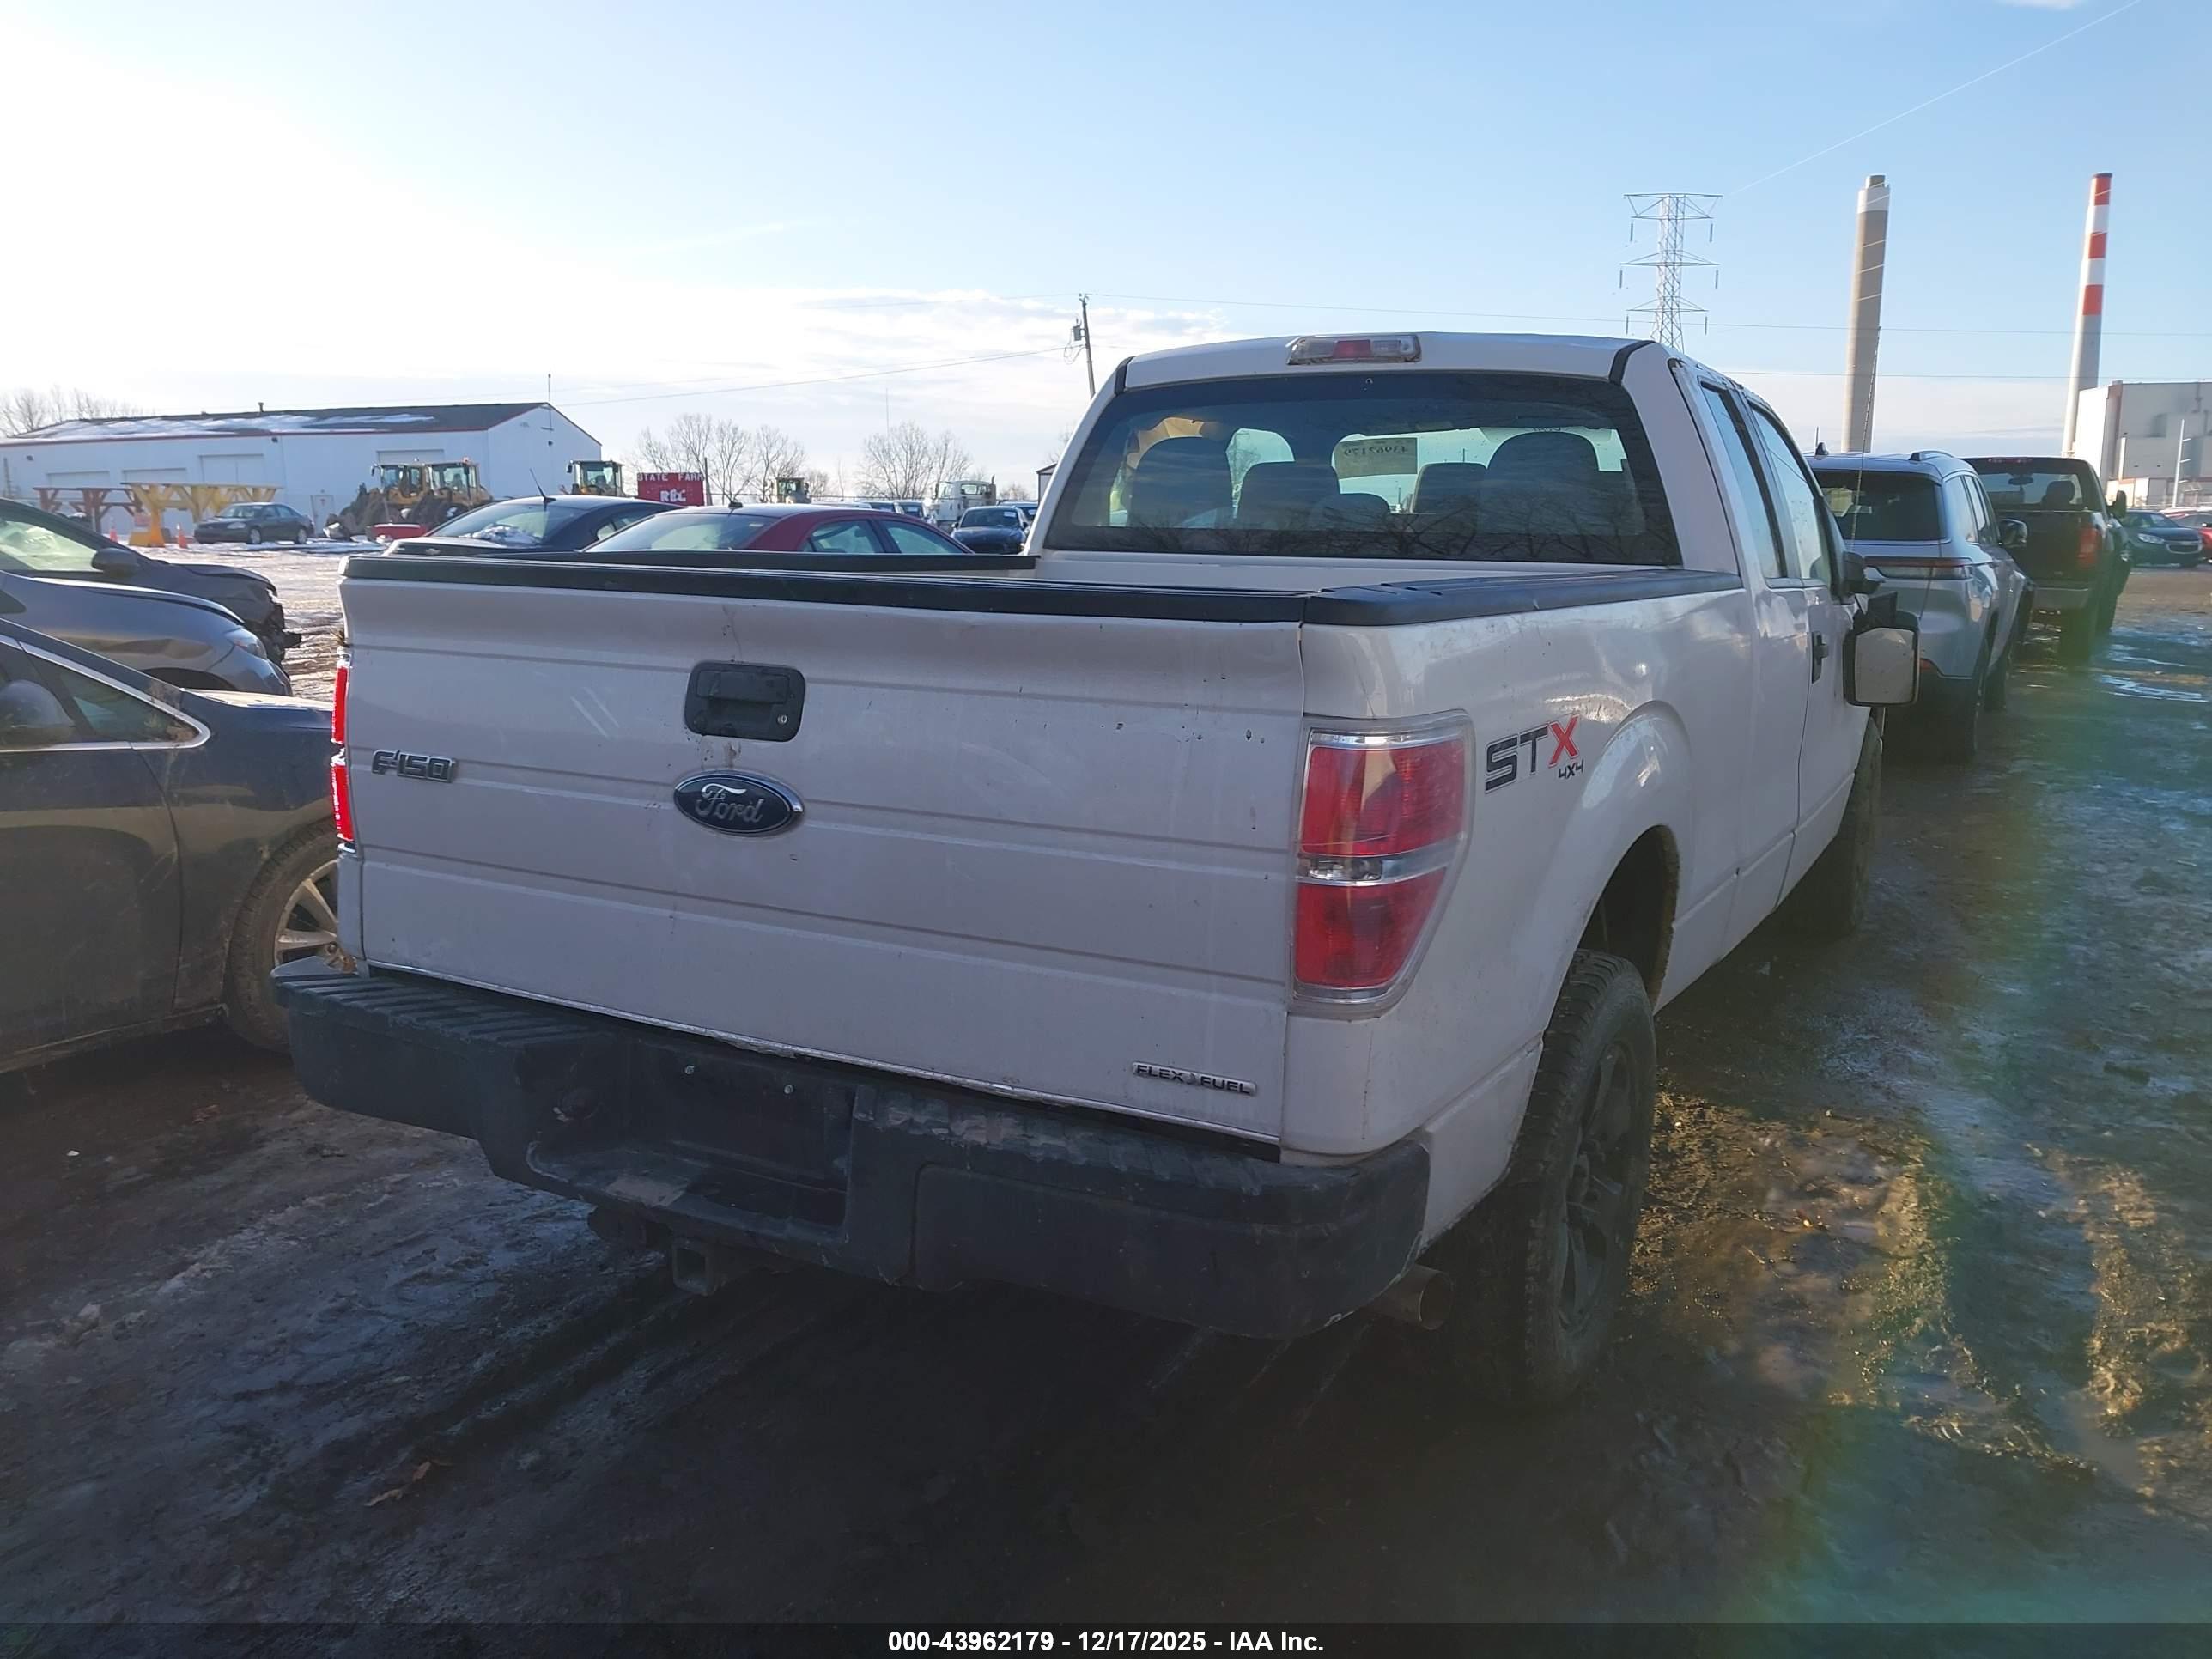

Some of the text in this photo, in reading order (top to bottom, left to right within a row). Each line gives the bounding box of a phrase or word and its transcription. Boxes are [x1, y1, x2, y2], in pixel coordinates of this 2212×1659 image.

[1484, 714, 1580, 793] STX
[695, 782, 765, 823] Ford
[1136, 1064, 1251, 1094] FLEX FUEL
